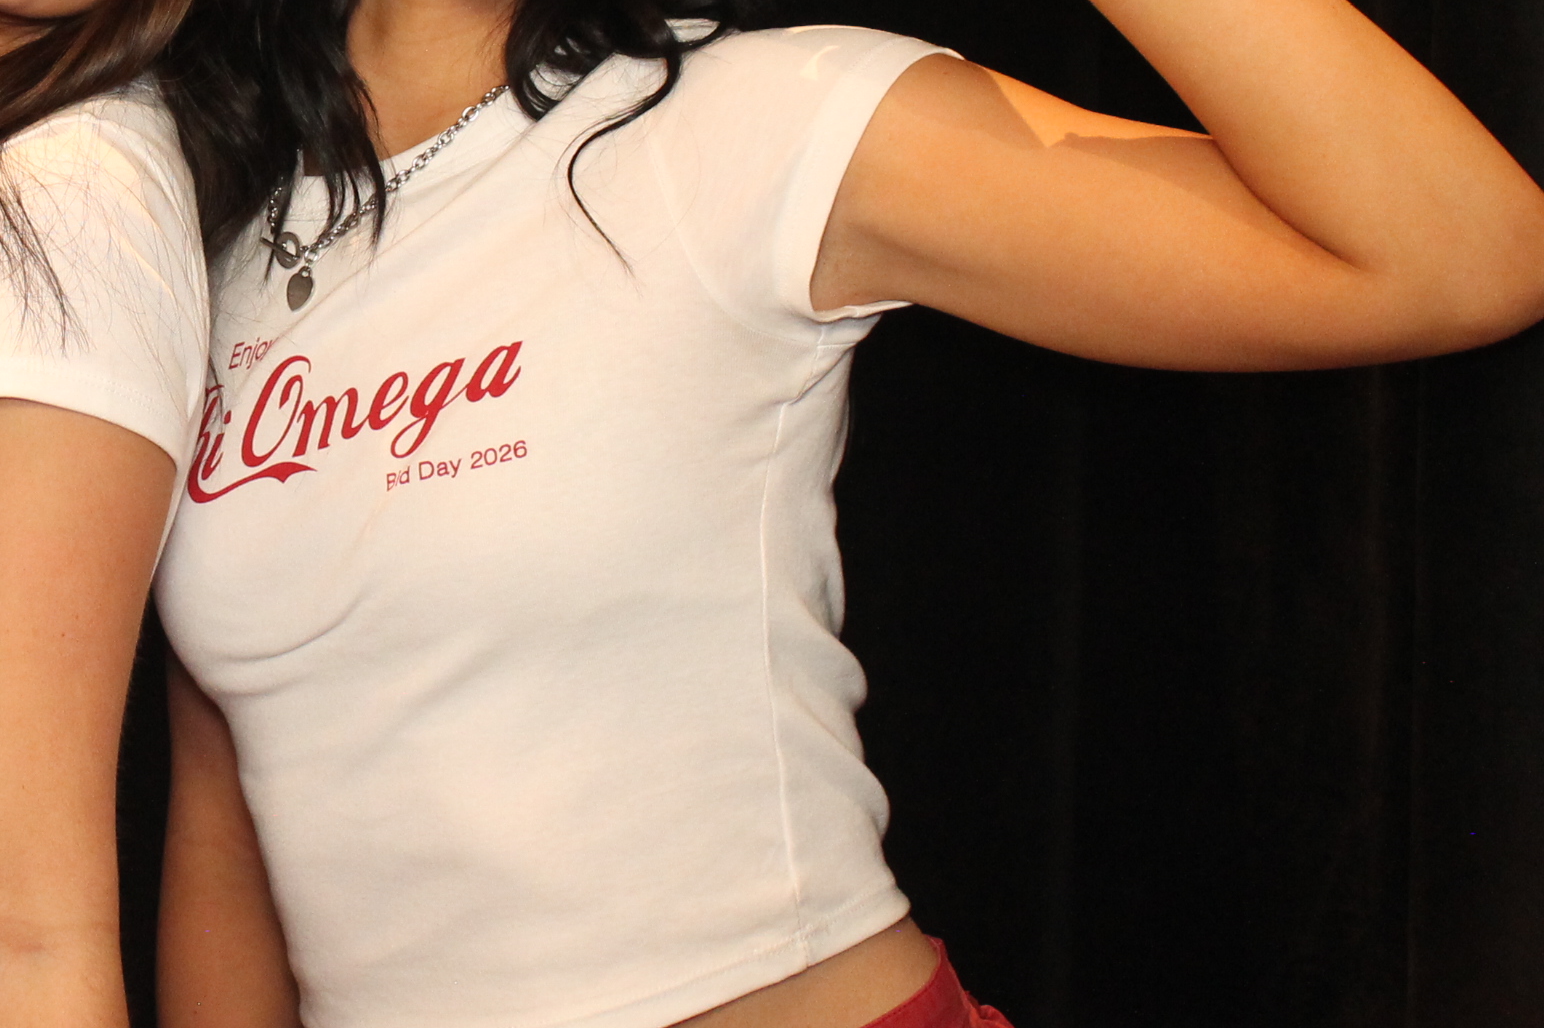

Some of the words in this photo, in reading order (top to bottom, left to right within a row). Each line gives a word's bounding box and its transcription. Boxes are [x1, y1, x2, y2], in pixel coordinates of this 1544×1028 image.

[241, 341, 523, 468] Omega
[418, 458, 462, 481] Day
[470, 440, 528, 470] 2026
